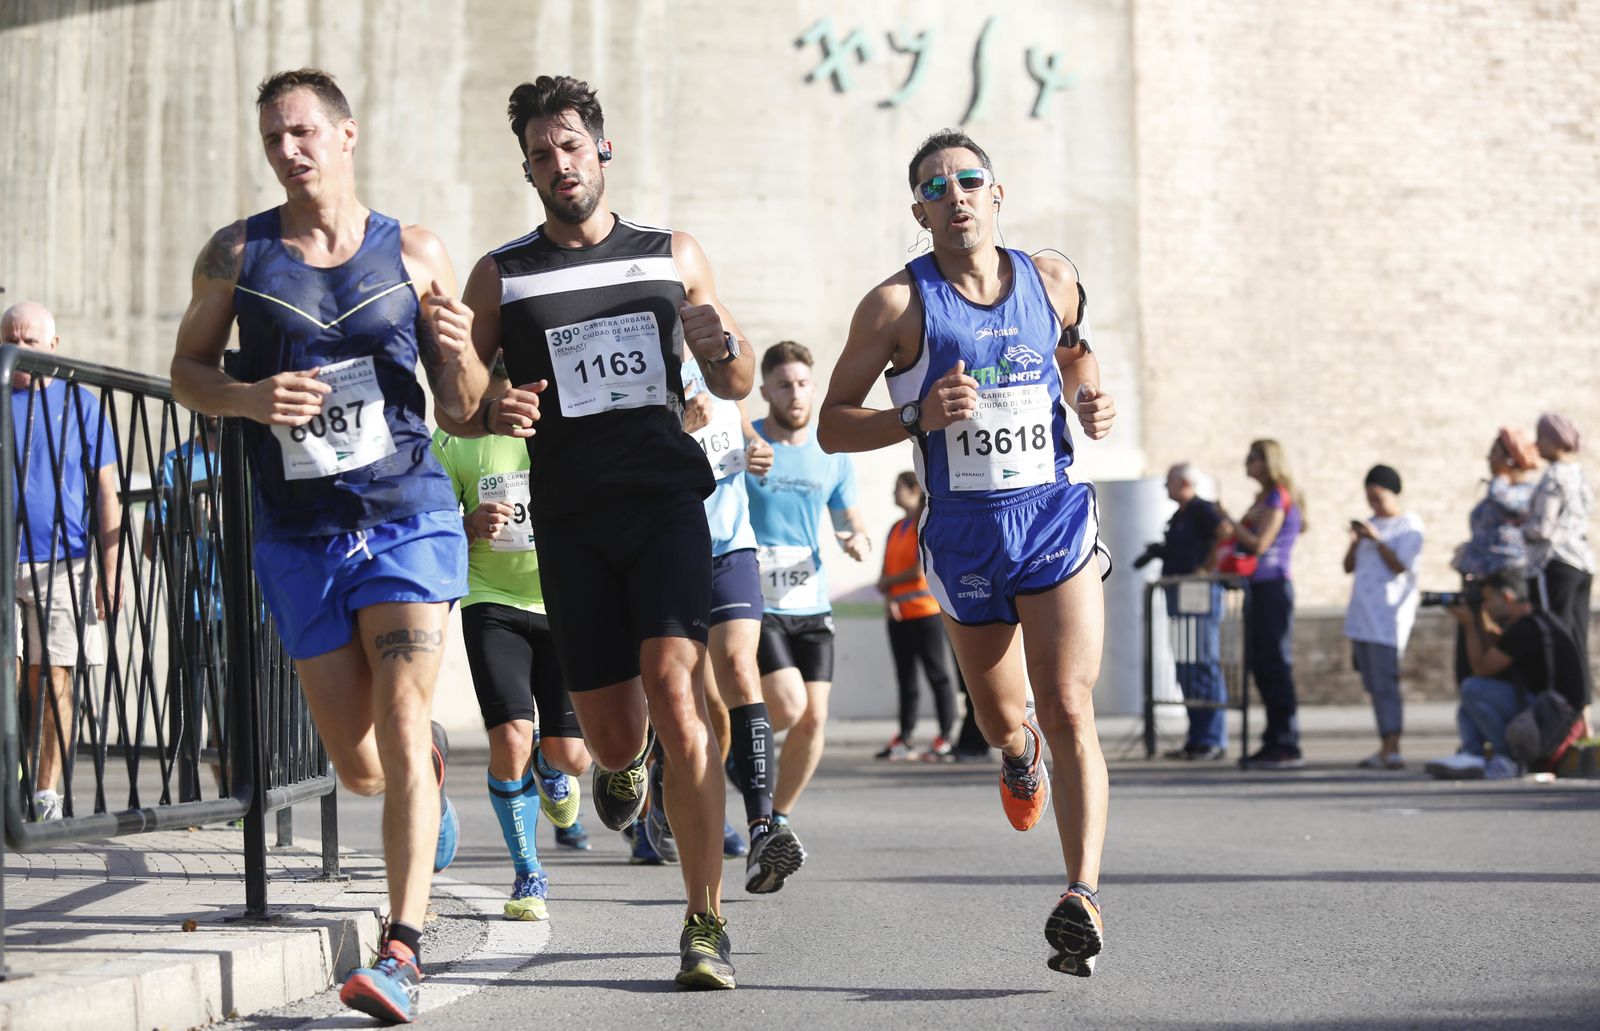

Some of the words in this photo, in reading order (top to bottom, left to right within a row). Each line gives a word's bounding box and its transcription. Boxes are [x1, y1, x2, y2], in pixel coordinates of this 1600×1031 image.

[582, 329, 610, 340] CIUDAD
[612, 327, 622, 335] DE
[624, 323, 656, 333] MÁLAGA
[584, 319, 618, 331] CARRERA
[620, 315, 651, 325] URBANA
[574, 350, 647, 384] 1163
[979, 401, 1008, 410] CIUDAD
[956, 423, 1046, 456] 13618
[505, 480, 529, 489] CIUDAD
[506, 472, 530, 481] CARRE
[769, 571, 810, 588] 1152
[745, 717, 770, 789] kalenji
[506, 799, 530, 859] kalenji
